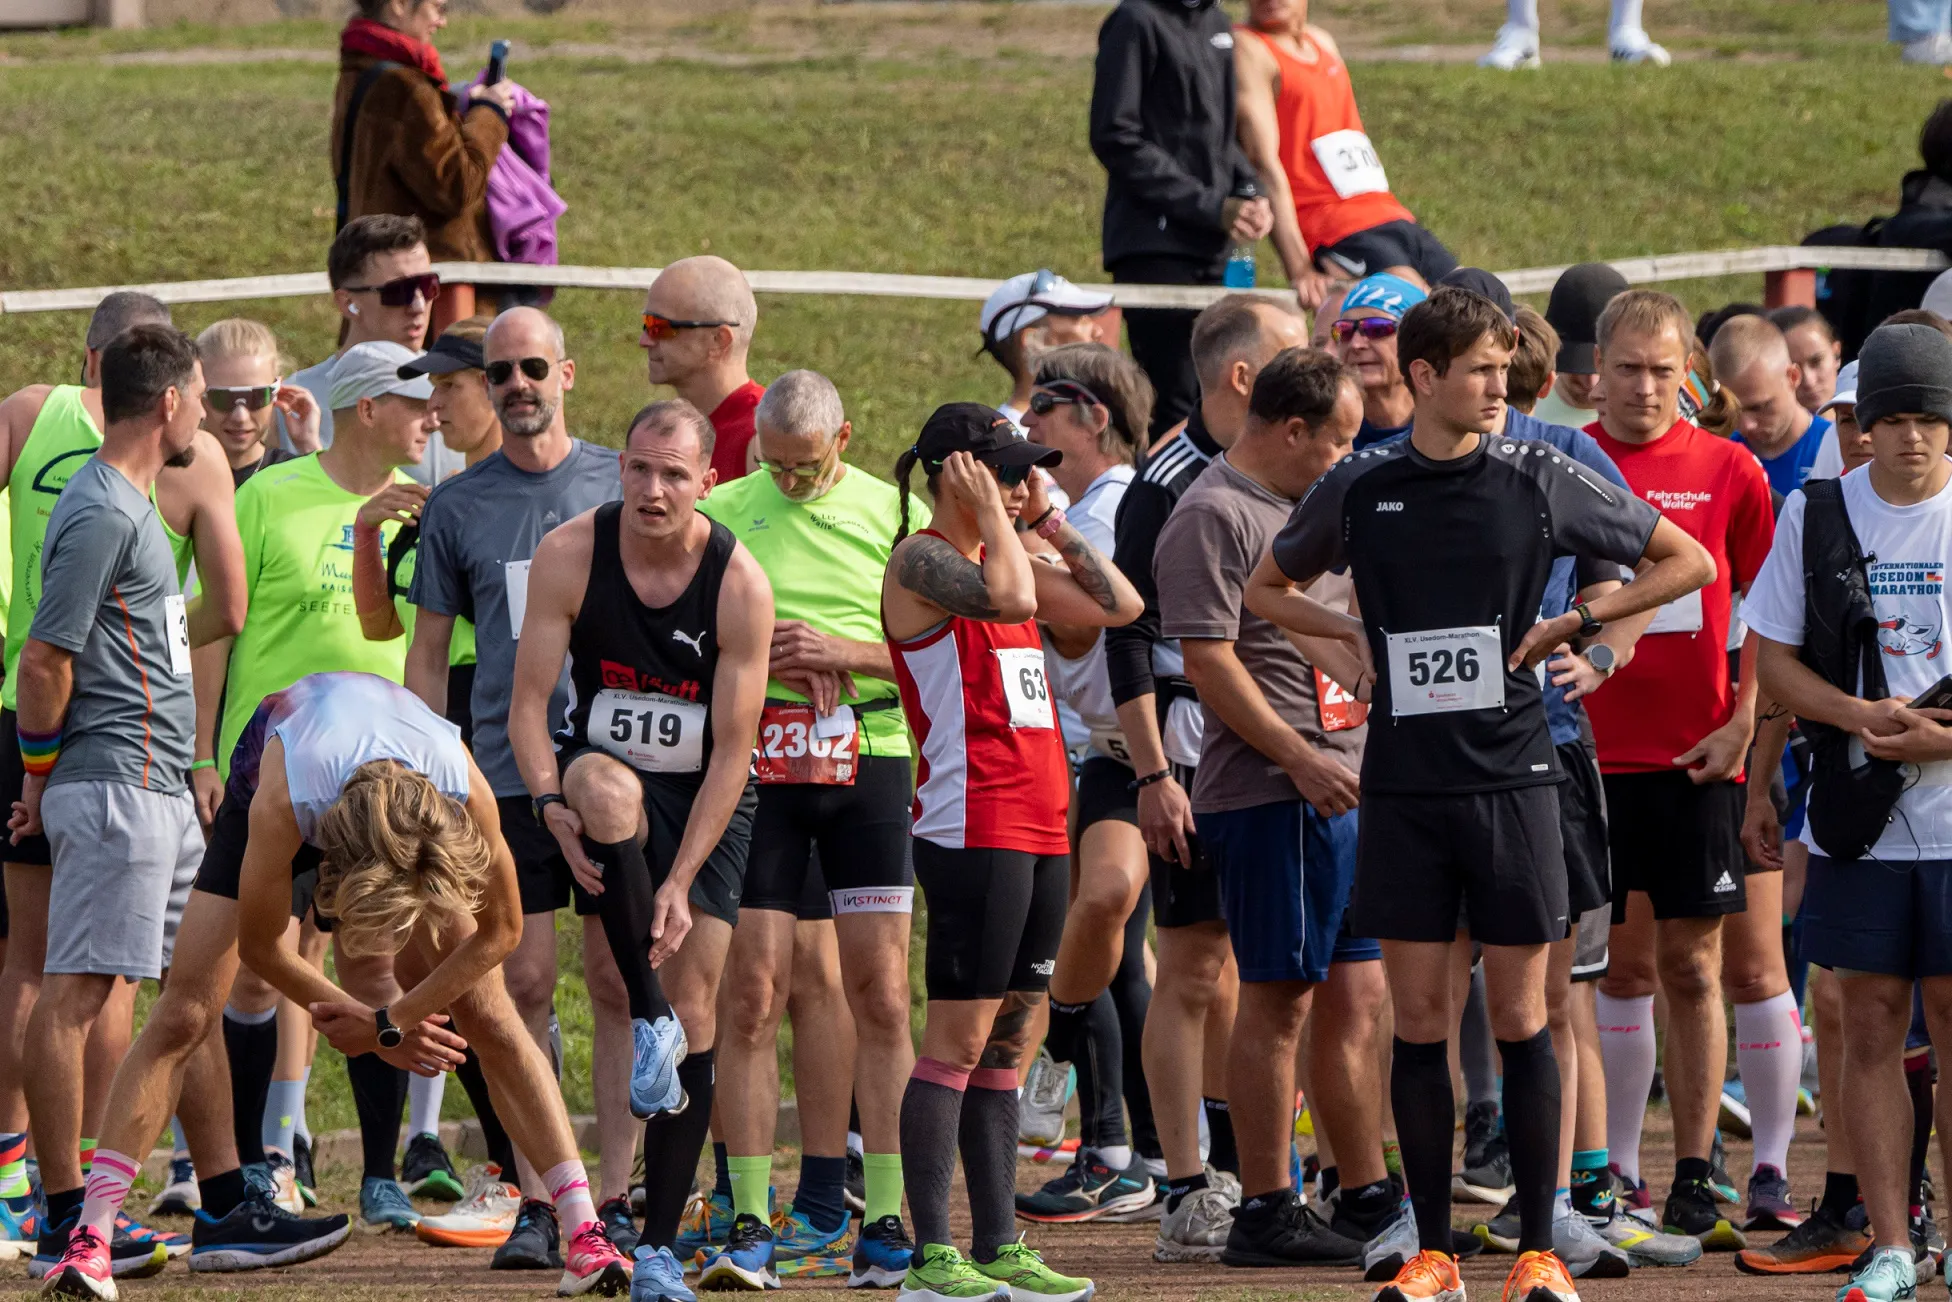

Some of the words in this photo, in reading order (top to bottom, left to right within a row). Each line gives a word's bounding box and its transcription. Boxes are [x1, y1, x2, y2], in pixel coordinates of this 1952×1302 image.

[1646, 490, 1712, 502] Fahrschule
[1376, 501, 1405, 512] JAKO
[1869, 571, 1925, 583] USEDOM
[1869, 584, 1943, 595] MARATHON
[1420, 632, 1480, 642] Usedom-Marathon
[1408, 647, 1480, 687] 526
[629, 694, 689, 707] Usedom-Marathon
[609, 708, 682, 748] 519
